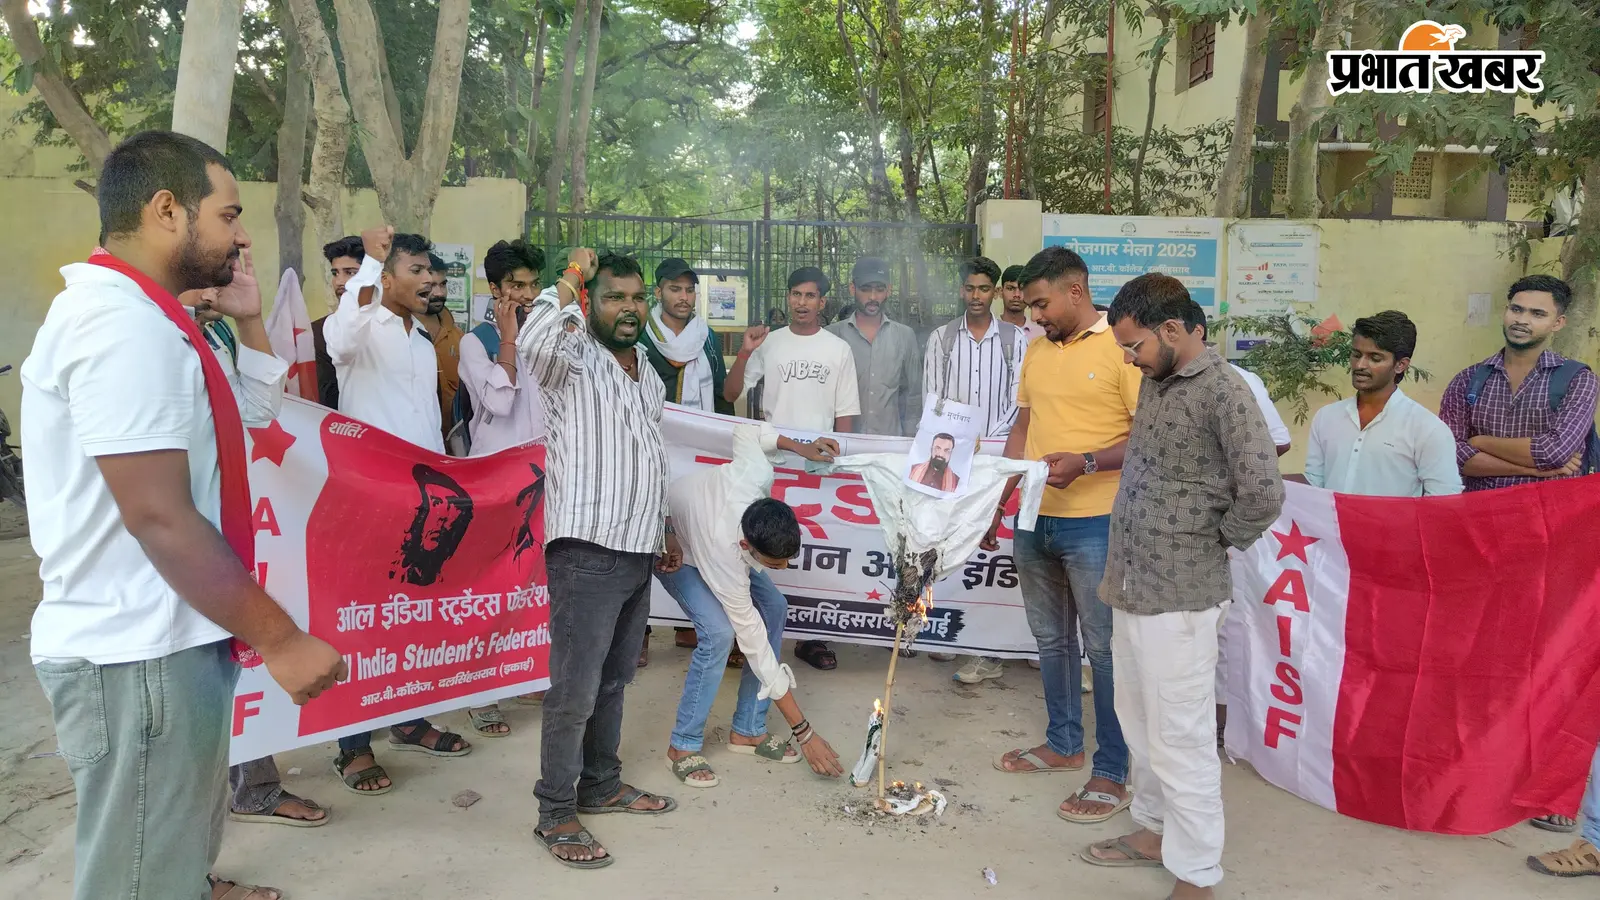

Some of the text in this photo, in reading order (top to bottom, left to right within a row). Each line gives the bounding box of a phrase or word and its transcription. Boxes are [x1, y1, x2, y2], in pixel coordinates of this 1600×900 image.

[1122, 239, 1154, 257] मेला
[1157, 243, 1197, 258] 2025
[777, 360, 830, 384] VIBES
[329, 421, 369, 439] शांति!
[336, 600, 376, 633] ऑल
[381, 593, 433, 630] इंडिया
[506, 582, 551, 611] फेडरेश
[356, 647, 397, 681] India
[402, 634, 485, 671] Student's
[499, 656, 535, 678] (इकाई)
[1263, 568, 1311, 750] AISF
